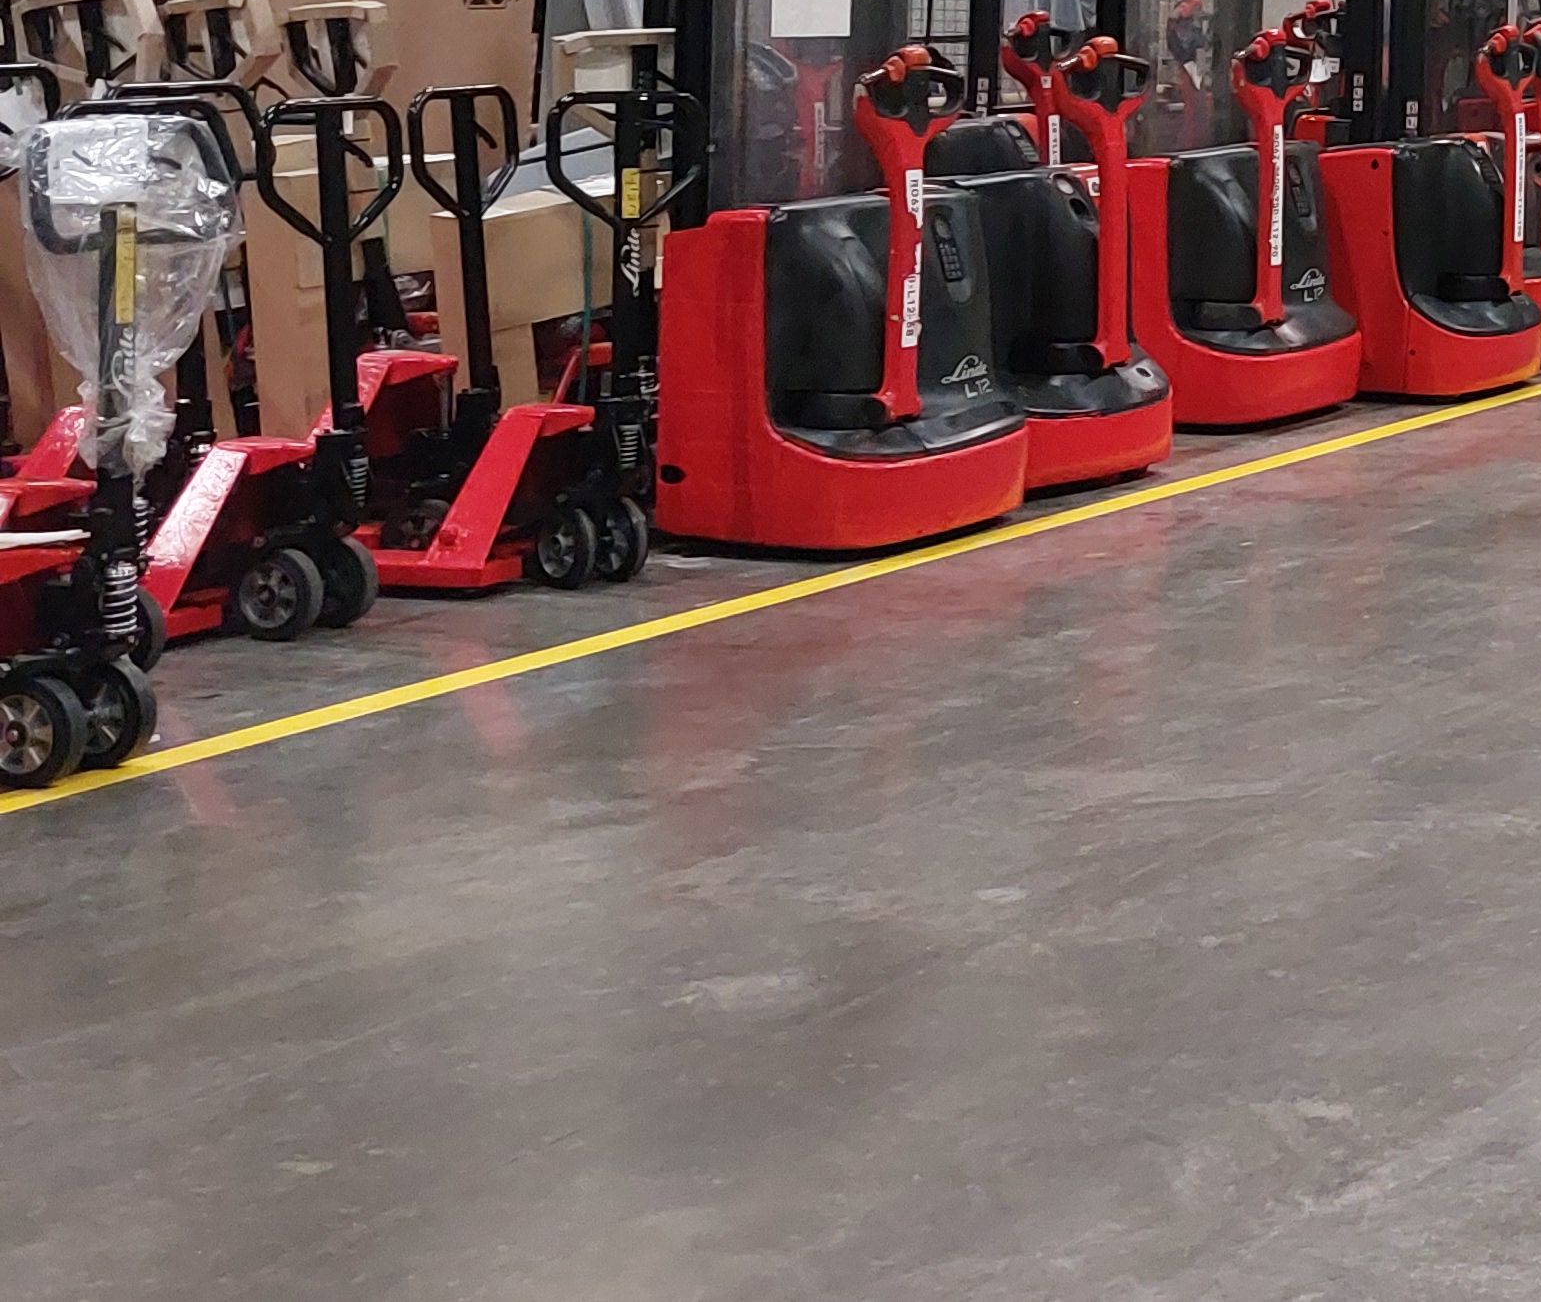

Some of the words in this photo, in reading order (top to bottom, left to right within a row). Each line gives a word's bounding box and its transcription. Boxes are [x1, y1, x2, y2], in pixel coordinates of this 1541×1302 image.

[620, 227, 640, 297] Linde
[1290, 268, 1326, 290] Linde
[940, 355, 988, 385] Linde
